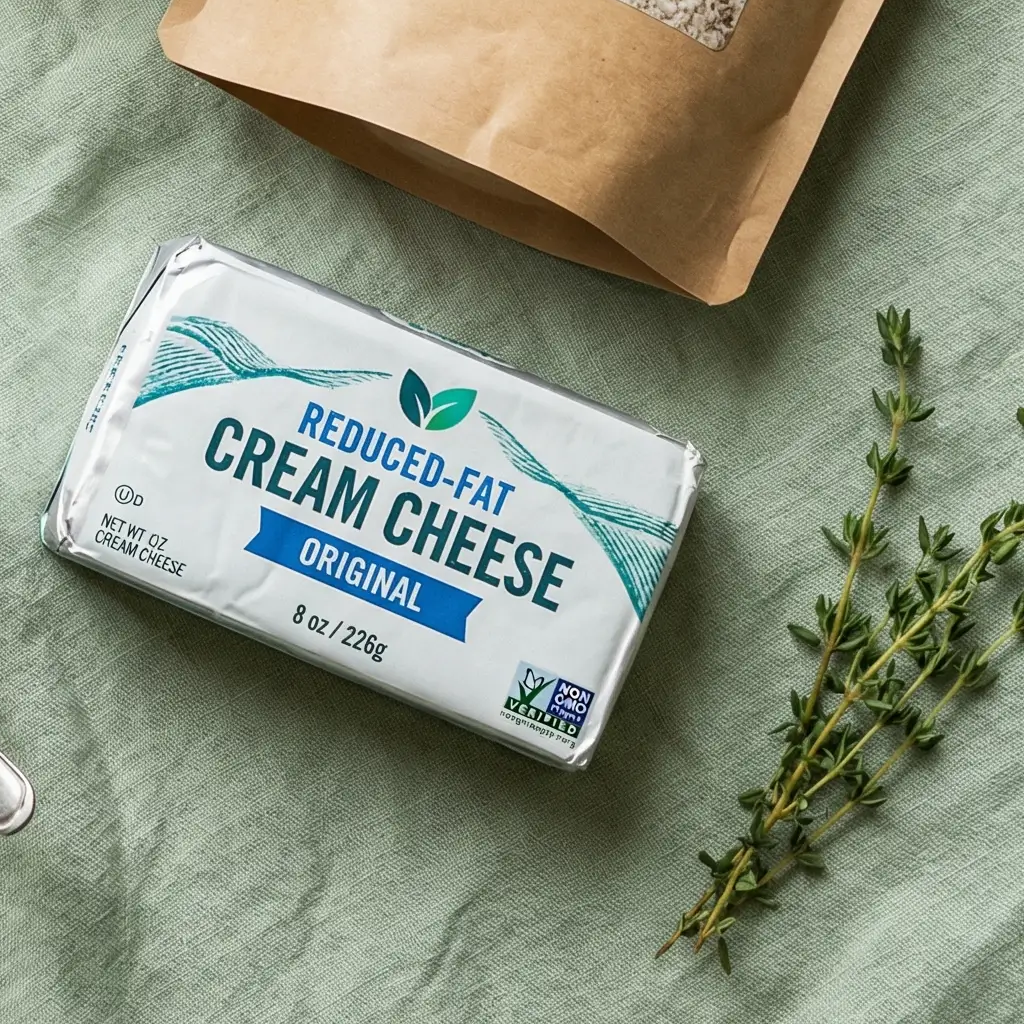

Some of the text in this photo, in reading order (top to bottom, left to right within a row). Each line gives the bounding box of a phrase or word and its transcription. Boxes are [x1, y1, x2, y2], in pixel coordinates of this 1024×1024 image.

[297, 401, 515, 516] REDUCED-FAT
[101, 513, 168, 551] NET WT OZ
[204, 417, 575, 613] CREAM CHEESE
[95, 530, 187, 577] CREAM CHEESE
[298, 538, 423, 613] ORIGINAL
[293, 604, 306, 624] 8
[308, 615, 328, 636] oz
[341, 623, 388, 663] 226g
[559, 682, 591, 704] NON
